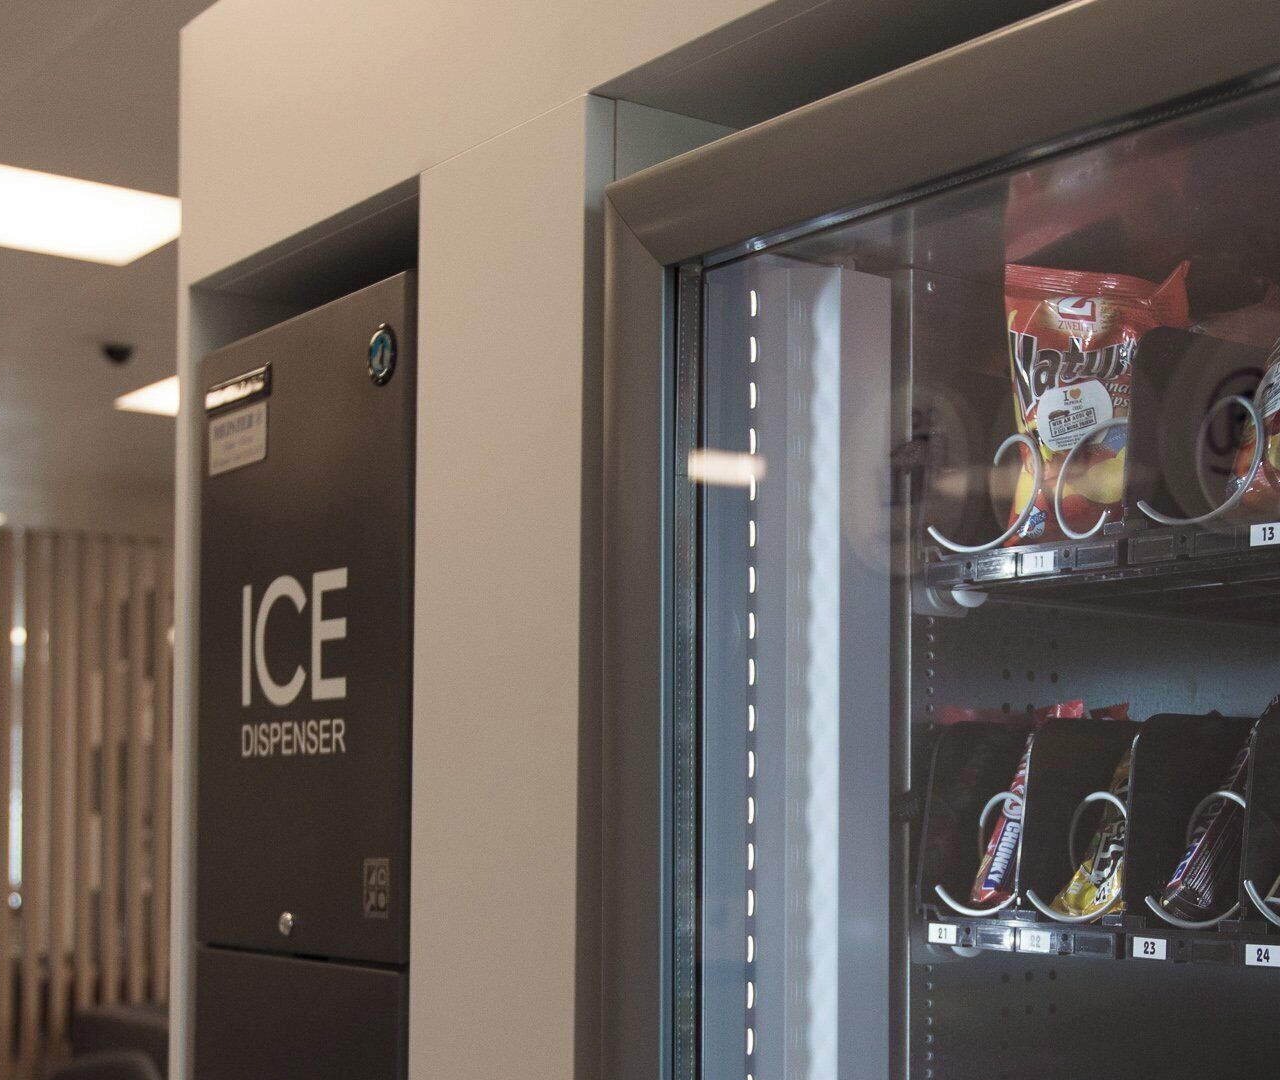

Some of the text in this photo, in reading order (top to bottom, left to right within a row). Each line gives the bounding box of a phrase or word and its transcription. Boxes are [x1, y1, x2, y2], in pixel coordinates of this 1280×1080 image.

[1262, 527, 1275, 541] 13
[242, 567, 348, 706] ICE
[241, 719, 346, 757] DISPENSER
[988, 821, 1020, 884] CHUNKY
[938, 927, 948, 940] 21
[1031, 935, 1041, 948] 22
[1143, 941, 1156, 955] 23
[1256, 948, 1270, 963] 24
